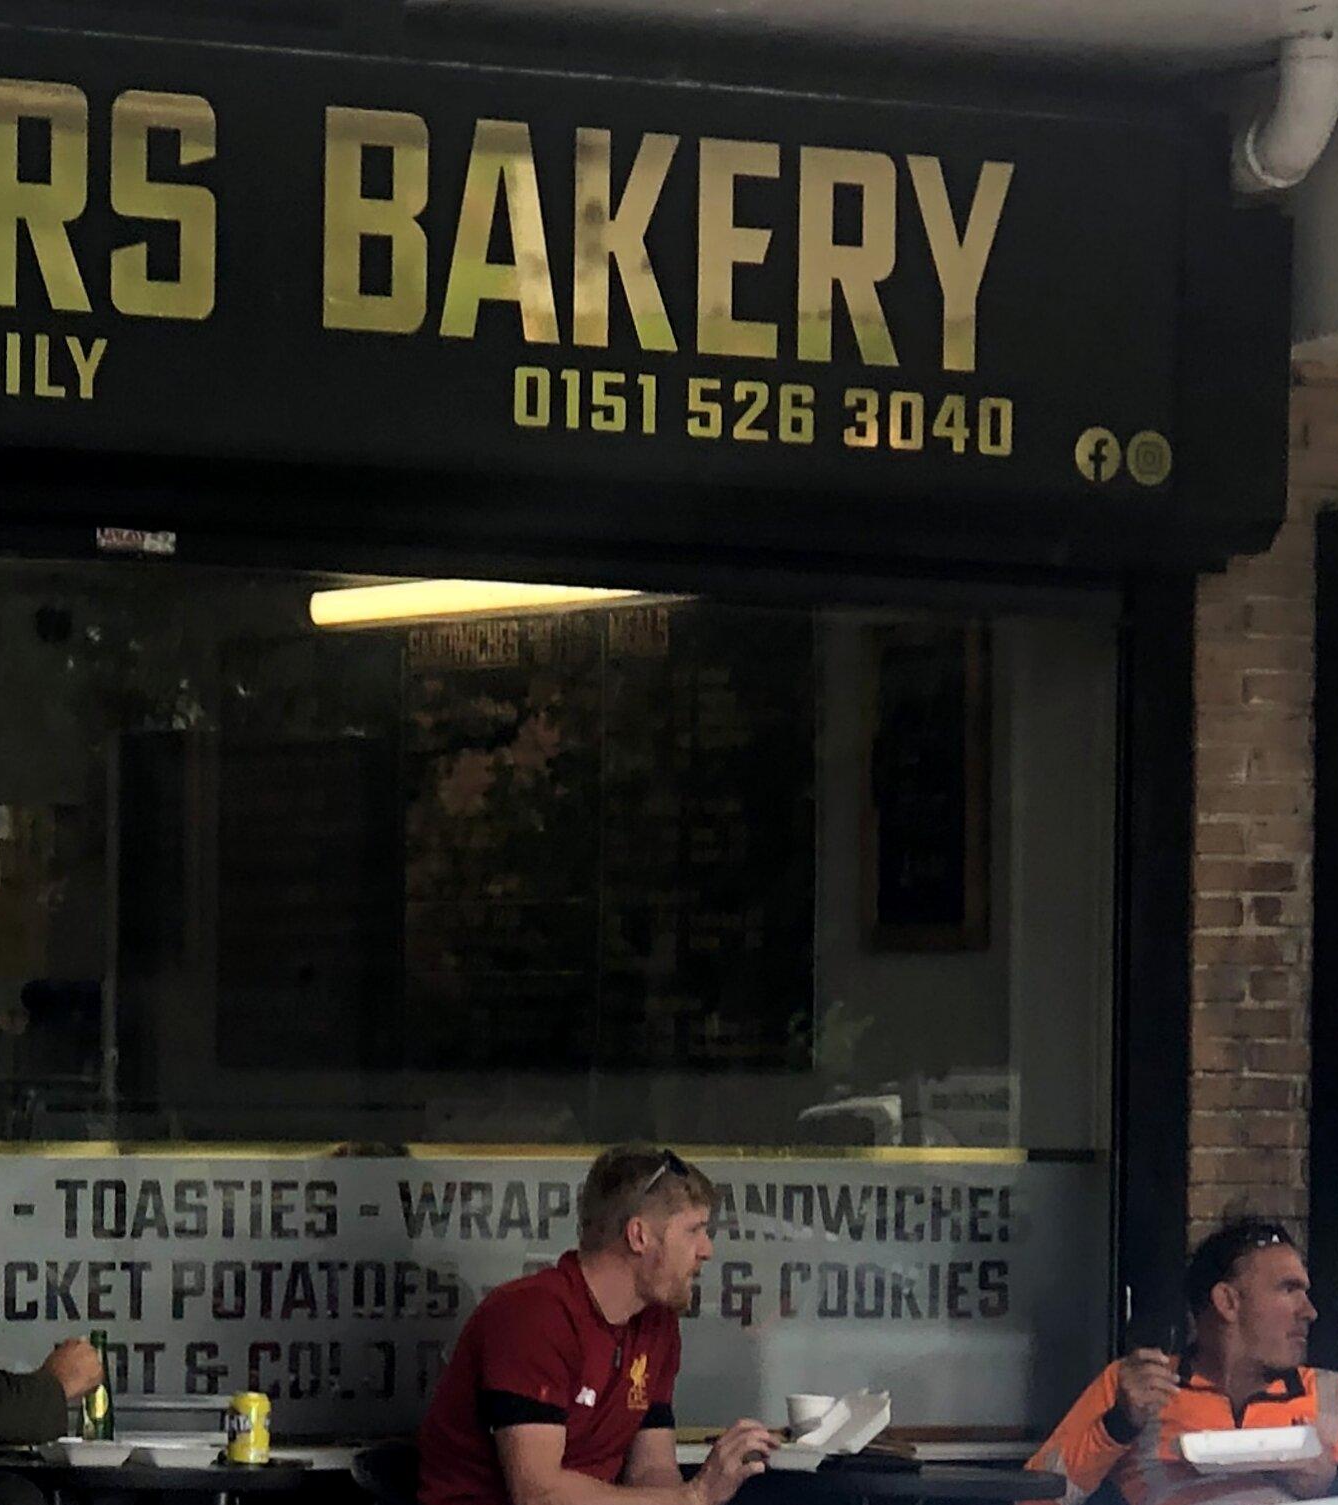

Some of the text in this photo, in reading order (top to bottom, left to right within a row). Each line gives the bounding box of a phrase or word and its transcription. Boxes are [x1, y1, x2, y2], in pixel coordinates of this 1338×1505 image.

[322, 105, 1016, 373] BAKERY
[513, 366, 1014, 457] 0151 526 3040
[55, 1179, 338, 1239] TOASTIES
[397, 1178, 586, 1240] WRAP
[171, 1261, 460, 1319] POTATOES
[720, 1261, 762, 1326] &
[780, 1261, 1010, 1319] COOKIES
[185, 1341, 229, 1395] &
